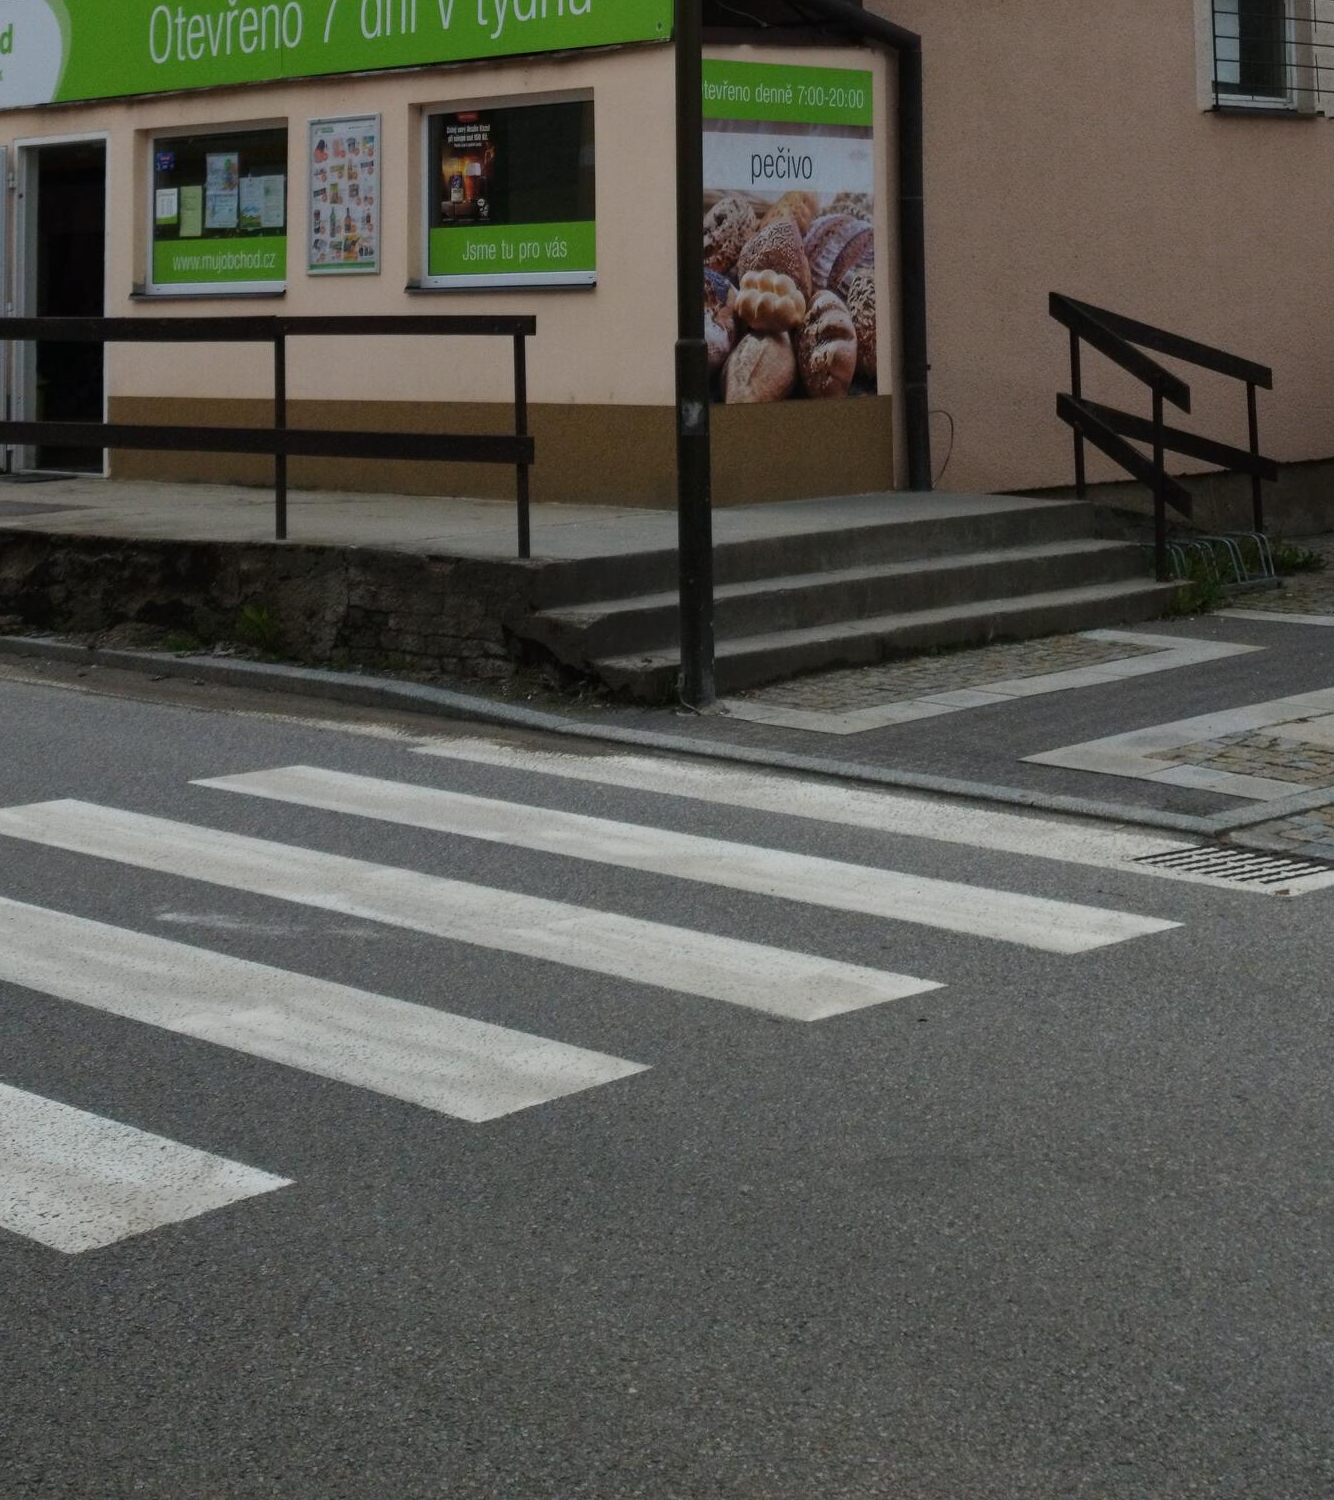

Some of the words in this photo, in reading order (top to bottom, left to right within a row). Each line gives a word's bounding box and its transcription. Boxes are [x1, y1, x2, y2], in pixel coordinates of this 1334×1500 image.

[702, 80, 750, 102] tevřeno
[755, 83, 793, 104] denně
[797, 86, 865, 108] 7:00-20:00
[751, 146, 813, 185] pečivo
[173, 250, 276, 273] www.mujobchod.cz
[462, 241, 496, 260] Jsme
[501, 239, 514, 260] tu
[519, 242, 540, 264] pro
[545, 236, 567, 258] vás
